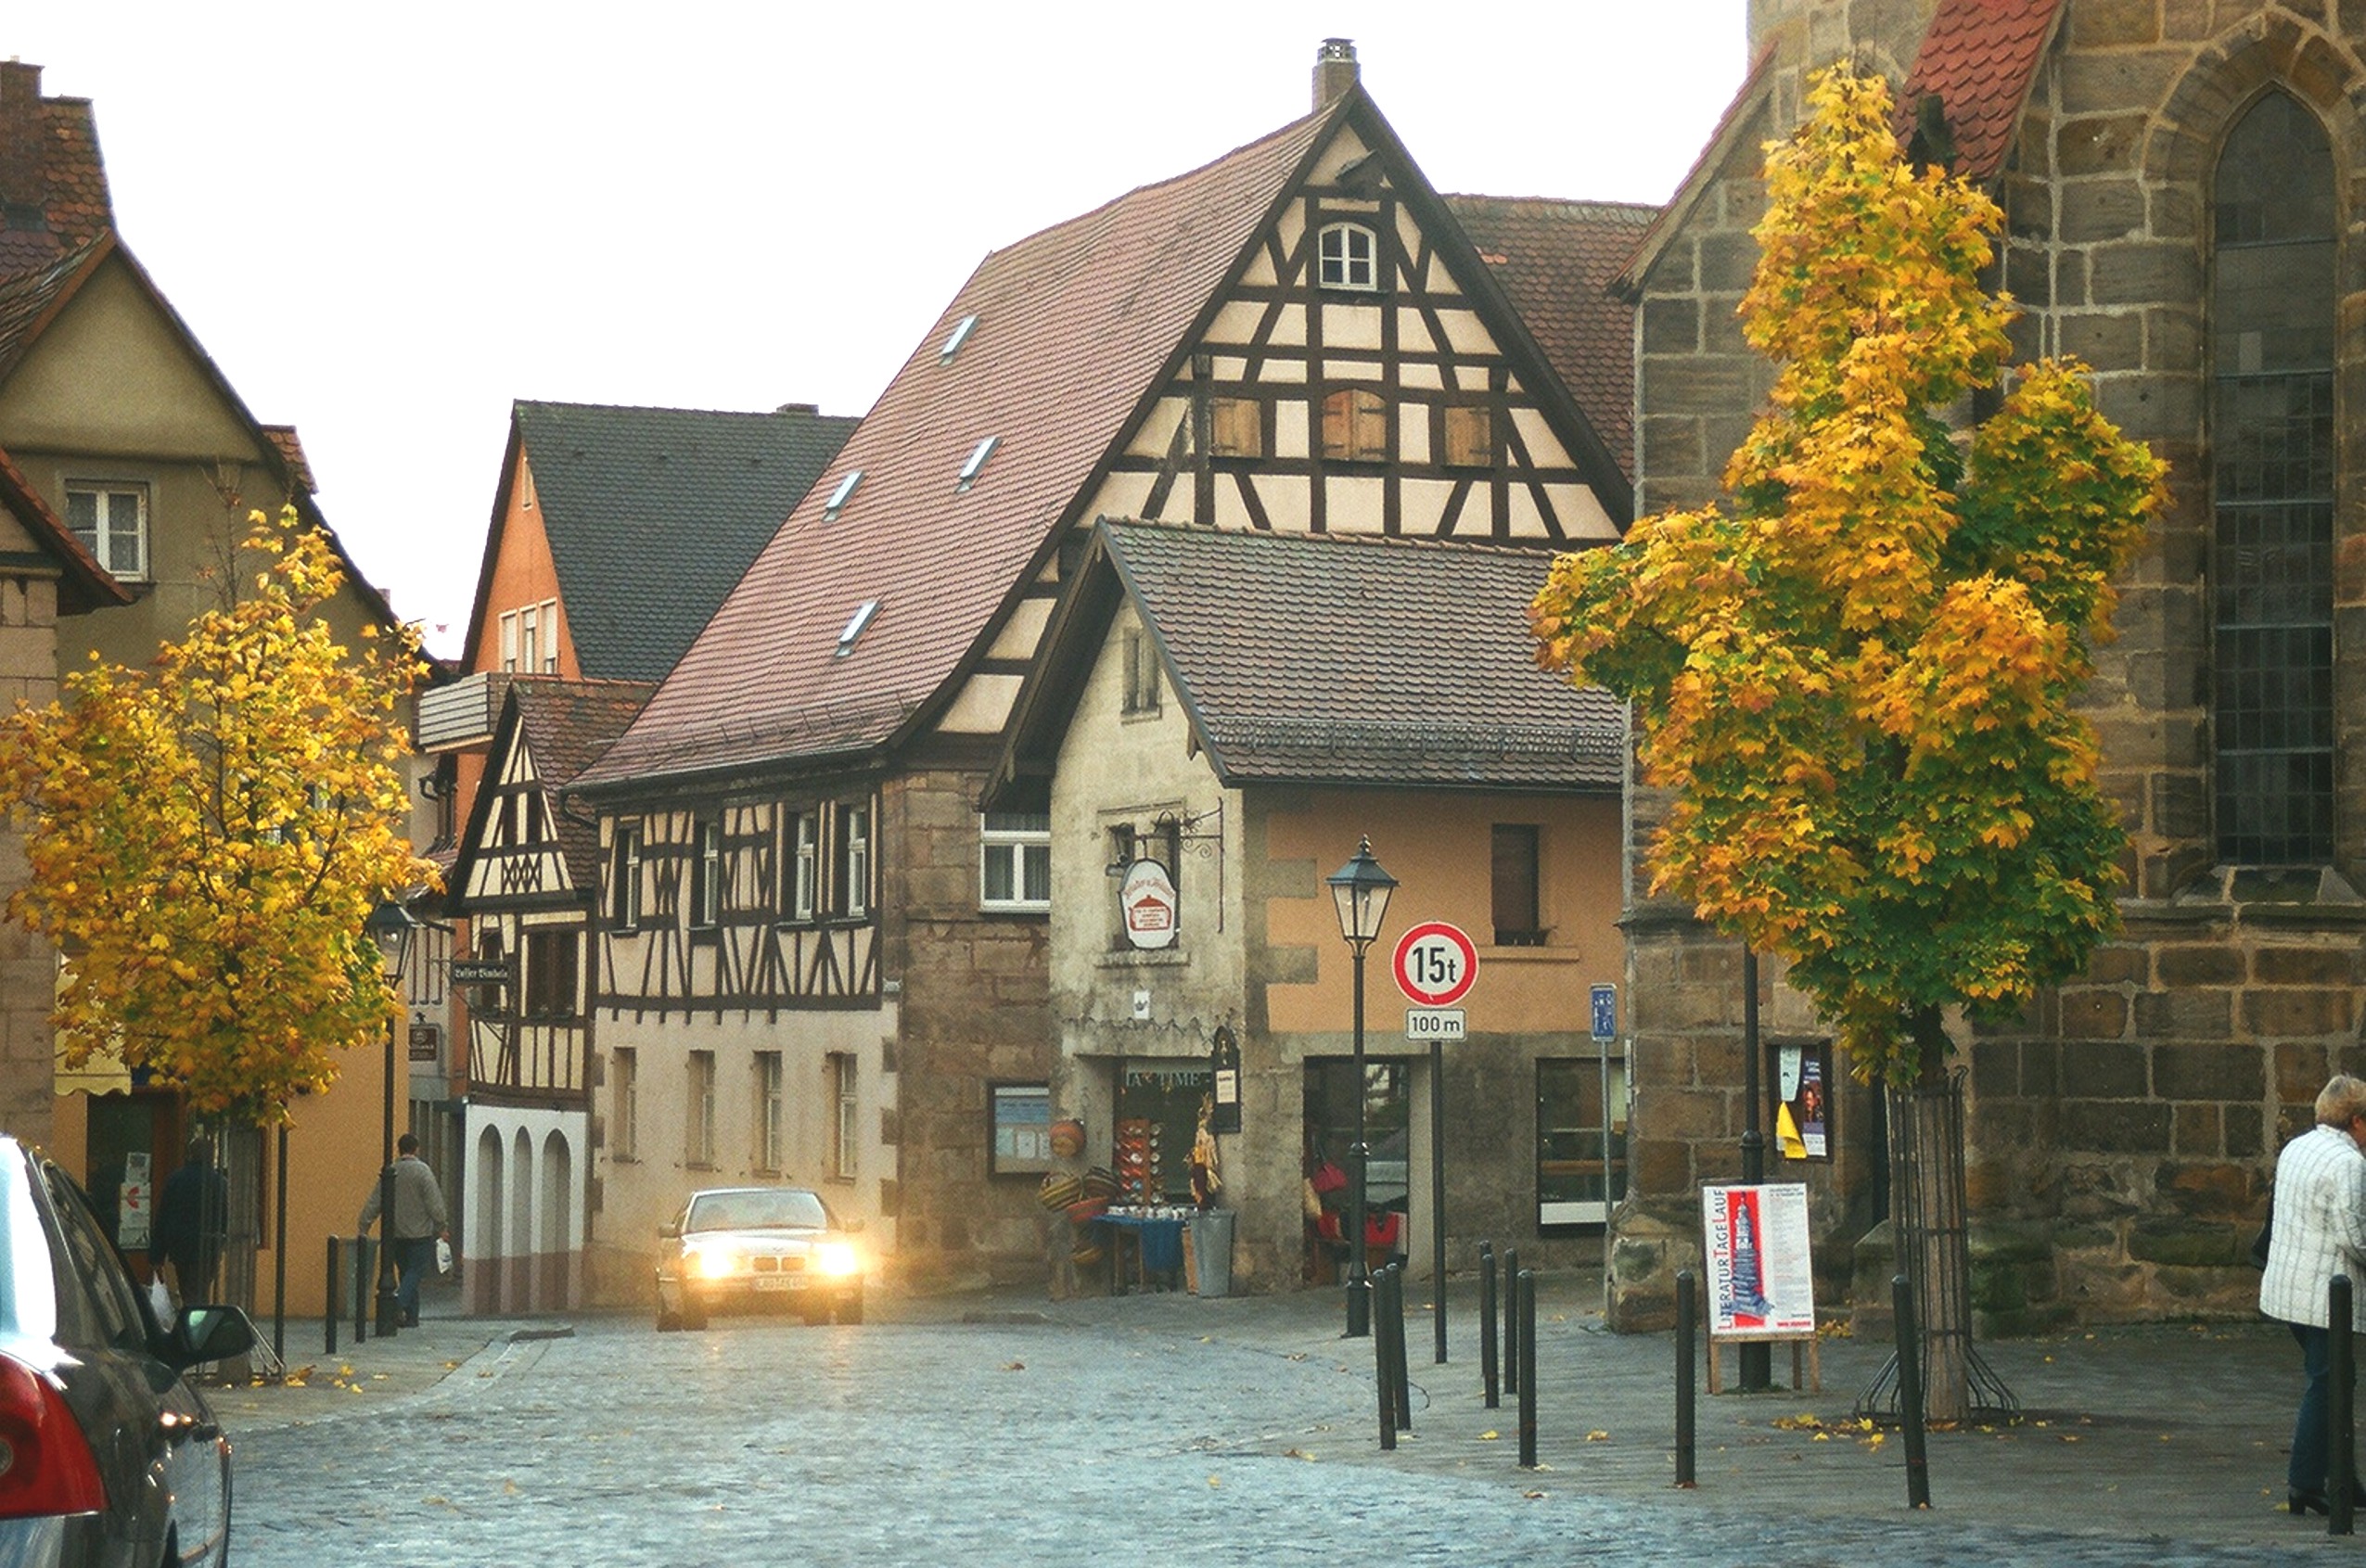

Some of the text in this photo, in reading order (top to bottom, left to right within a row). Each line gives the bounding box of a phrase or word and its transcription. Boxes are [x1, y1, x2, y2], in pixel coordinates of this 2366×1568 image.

[1413, 947, 1456, 984] 15t
[1413, 1016, 1460, 1032] 100 m
